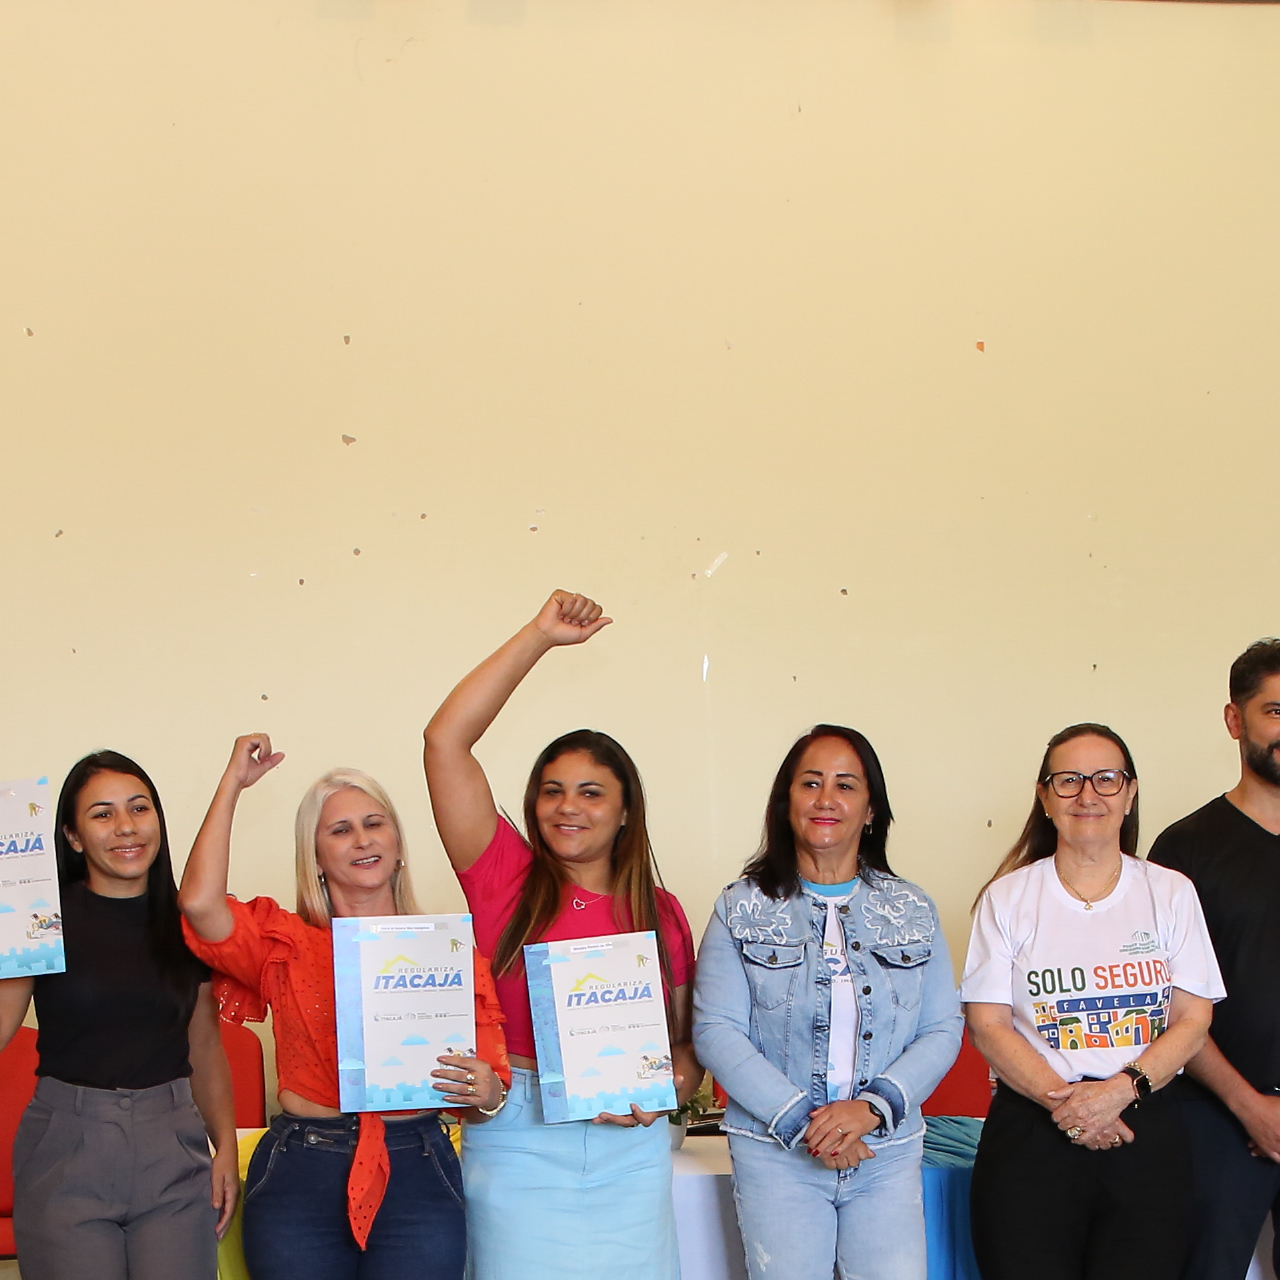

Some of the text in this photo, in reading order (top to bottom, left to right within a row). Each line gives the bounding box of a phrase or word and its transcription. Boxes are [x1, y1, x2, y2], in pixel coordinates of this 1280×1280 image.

[374, 969, 463, 989] ITACAJÁ
[589, 980, 643, 990] REGULARIZA
[1027, 967, 1086, 996] SOLO
[567, 982, 652, 1007] ITACAJÁ
[1063, 995, 1151, 1011] FAVELA
